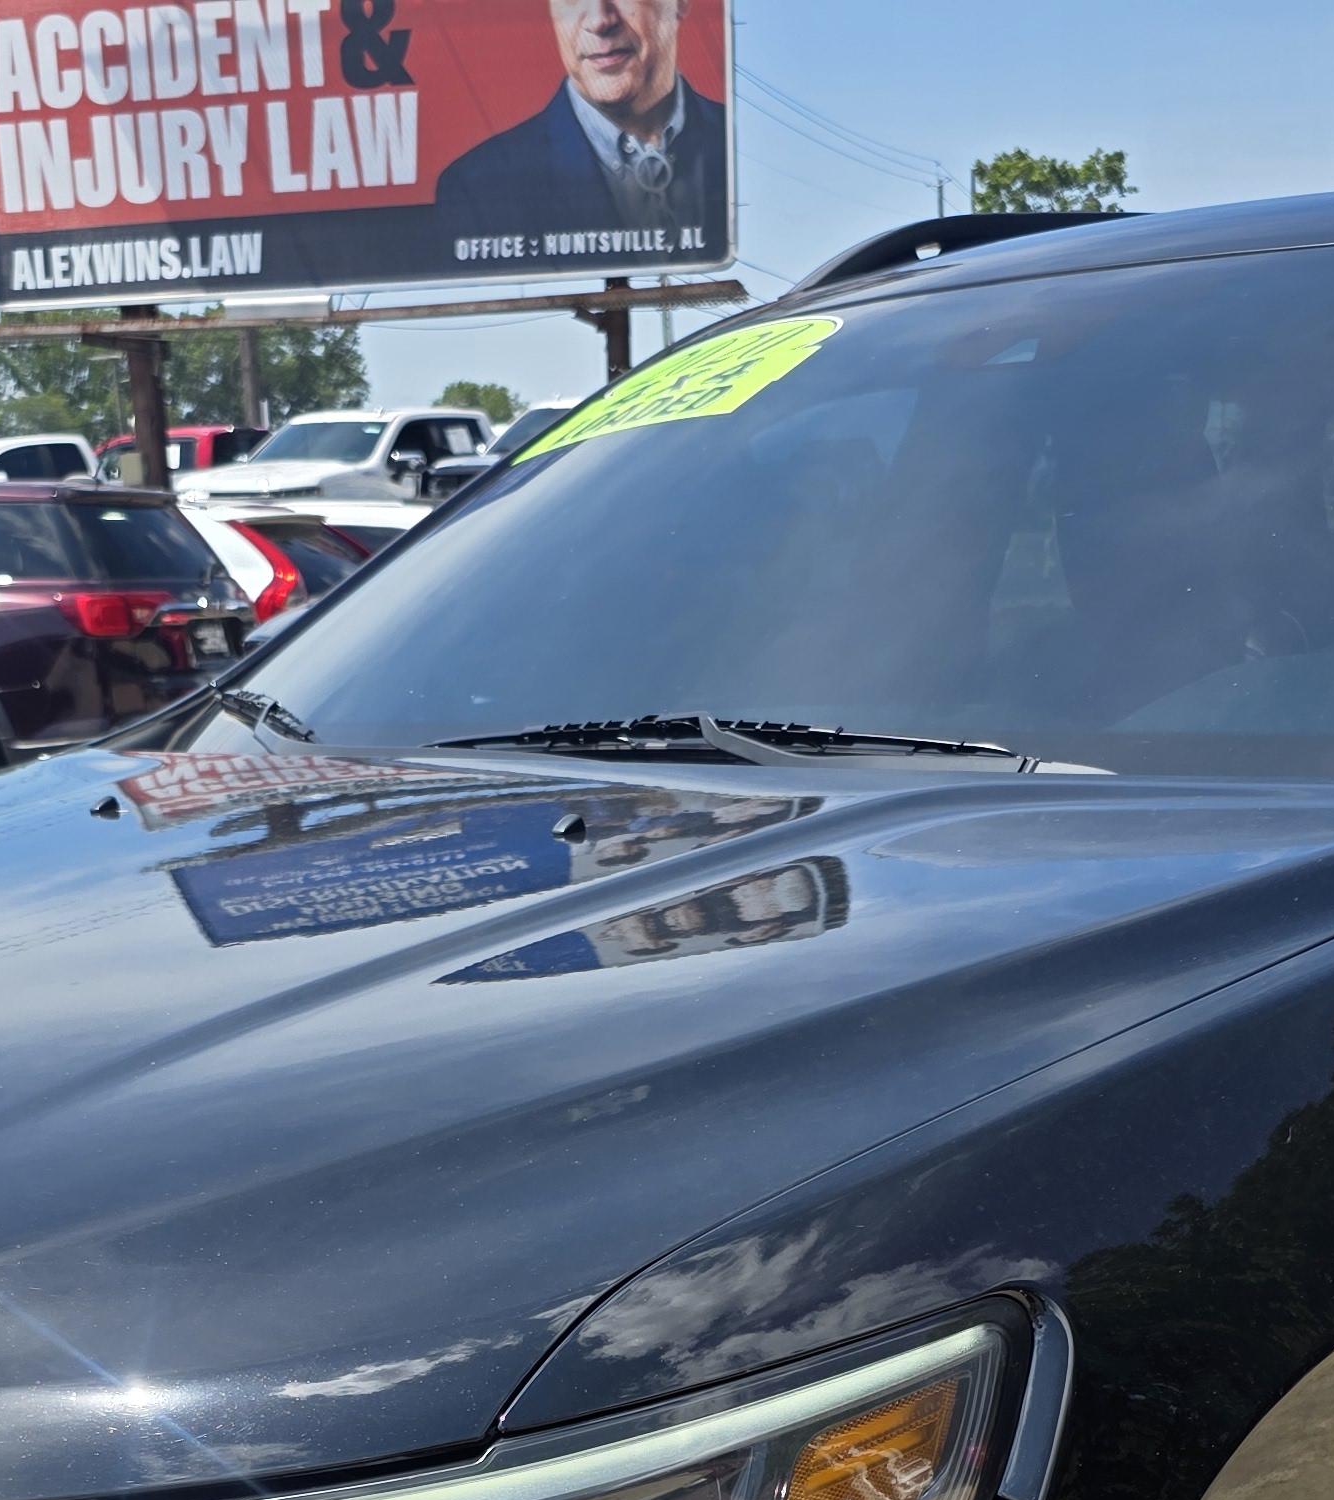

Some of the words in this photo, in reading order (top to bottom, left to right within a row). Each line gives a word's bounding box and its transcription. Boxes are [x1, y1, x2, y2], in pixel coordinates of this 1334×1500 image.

[340, 0, 416, 90] &
[266, 91, 418, 193] LAW
[10, 232, 263, 291] ALEXWINS.LAW
[543, 229, 674, 256] HUNTSVILLE,
[680, 226, 706, 250] AL
[552, 384, 735, 447] LOADED
